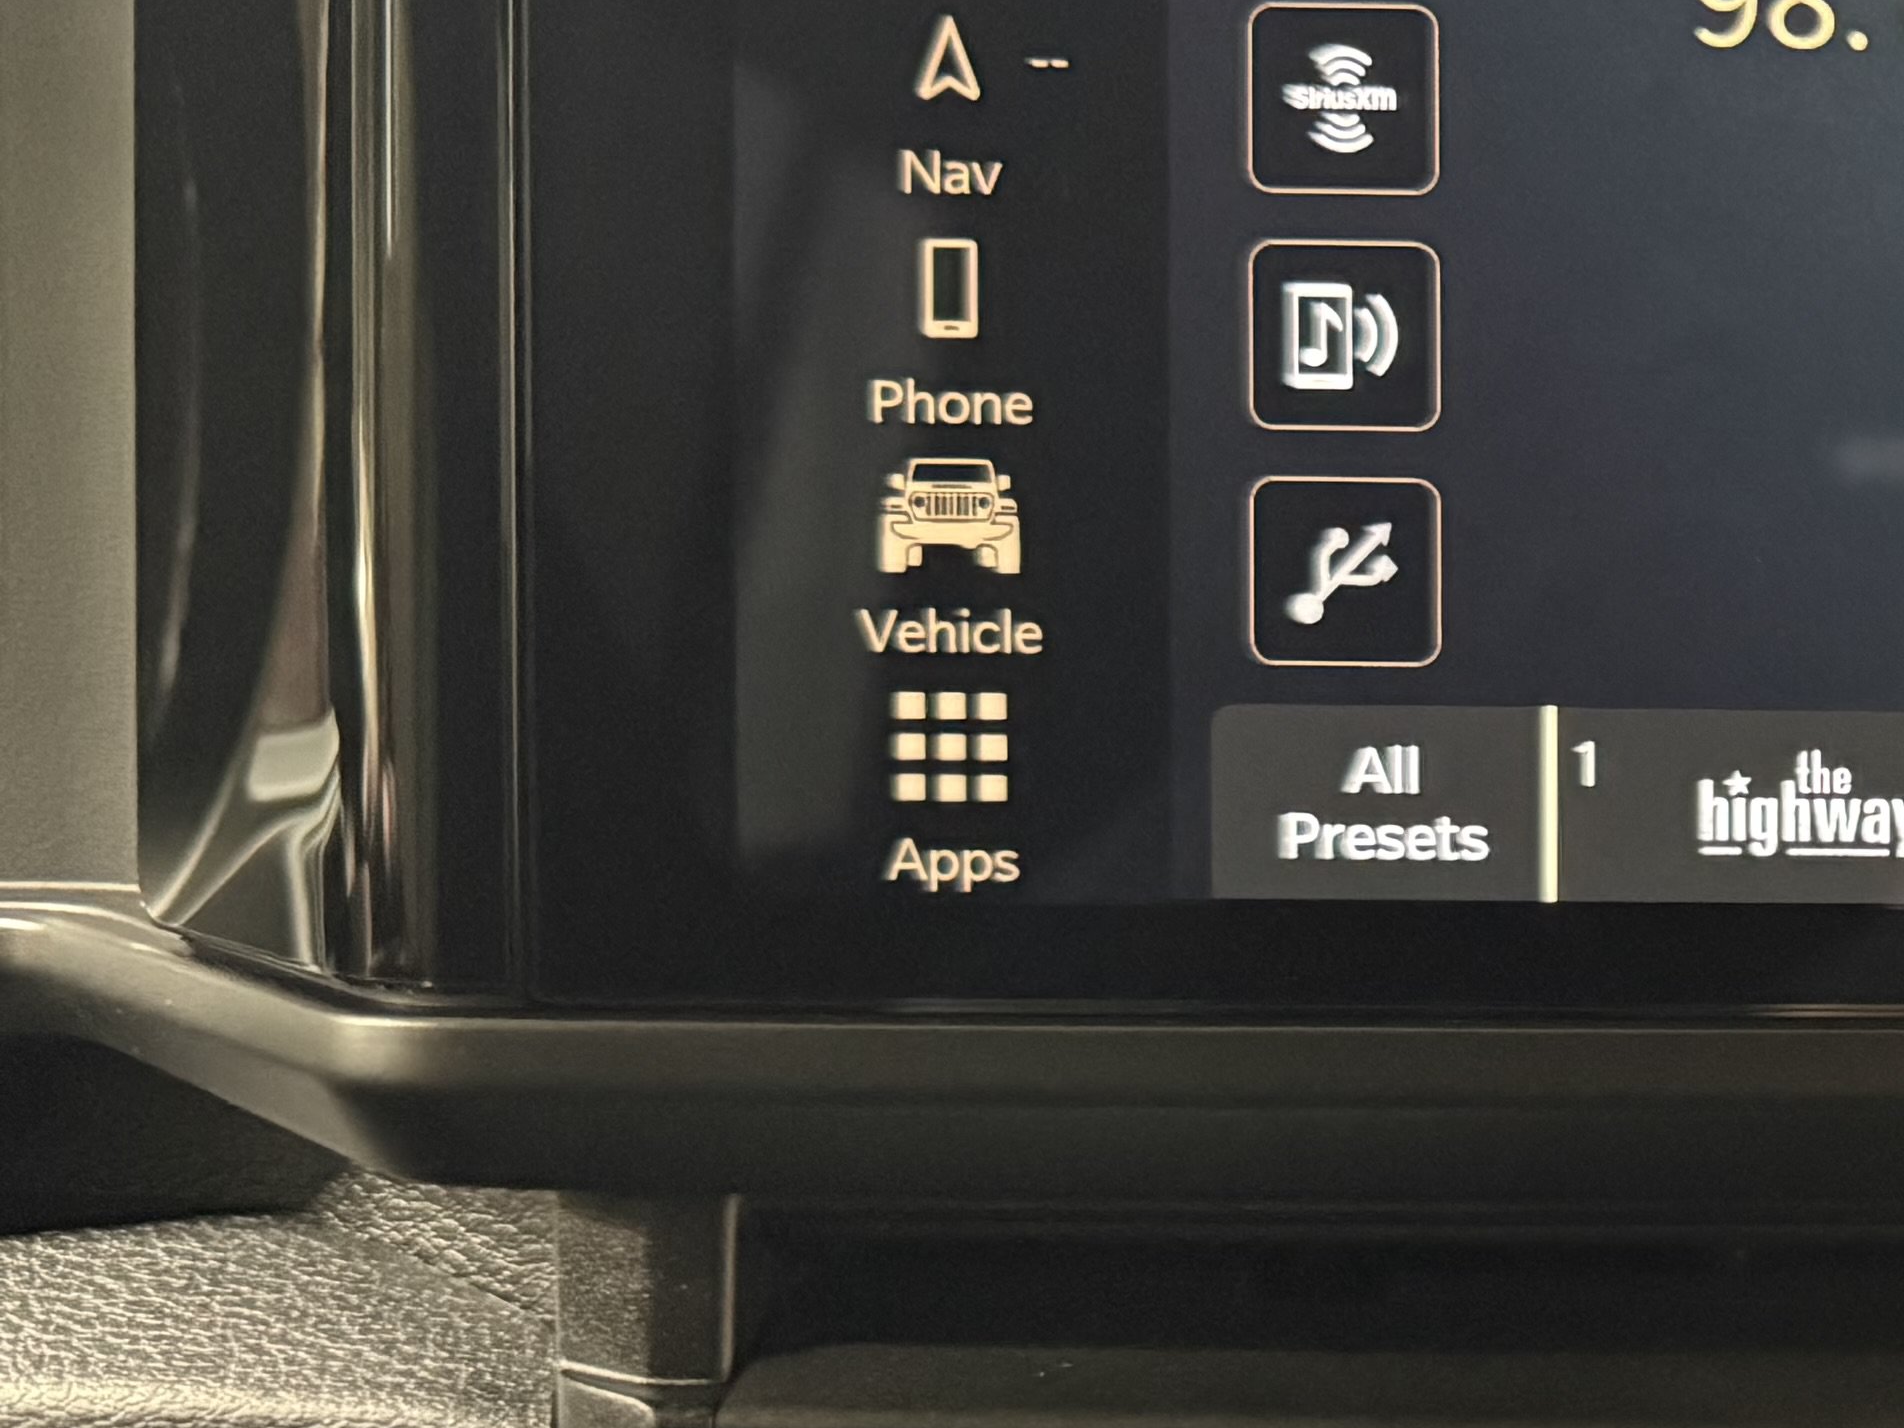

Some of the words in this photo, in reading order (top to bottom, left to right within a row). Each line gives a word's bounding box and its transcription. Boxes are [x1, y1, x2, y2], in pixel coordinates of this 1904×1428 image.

[898, 148, 1002, 196] Nav
[866, 378, 1034, 427] Phone
[855, 608, 1044, 656] Vehicle
[1340, 744, 1421, 795] All
[1572, 740, 1597, 788] 1
[1796, 749, 1852, 795] the
[1276, 811, 1491, 862] Presets
[883, 837, 1021, 893] Apps
